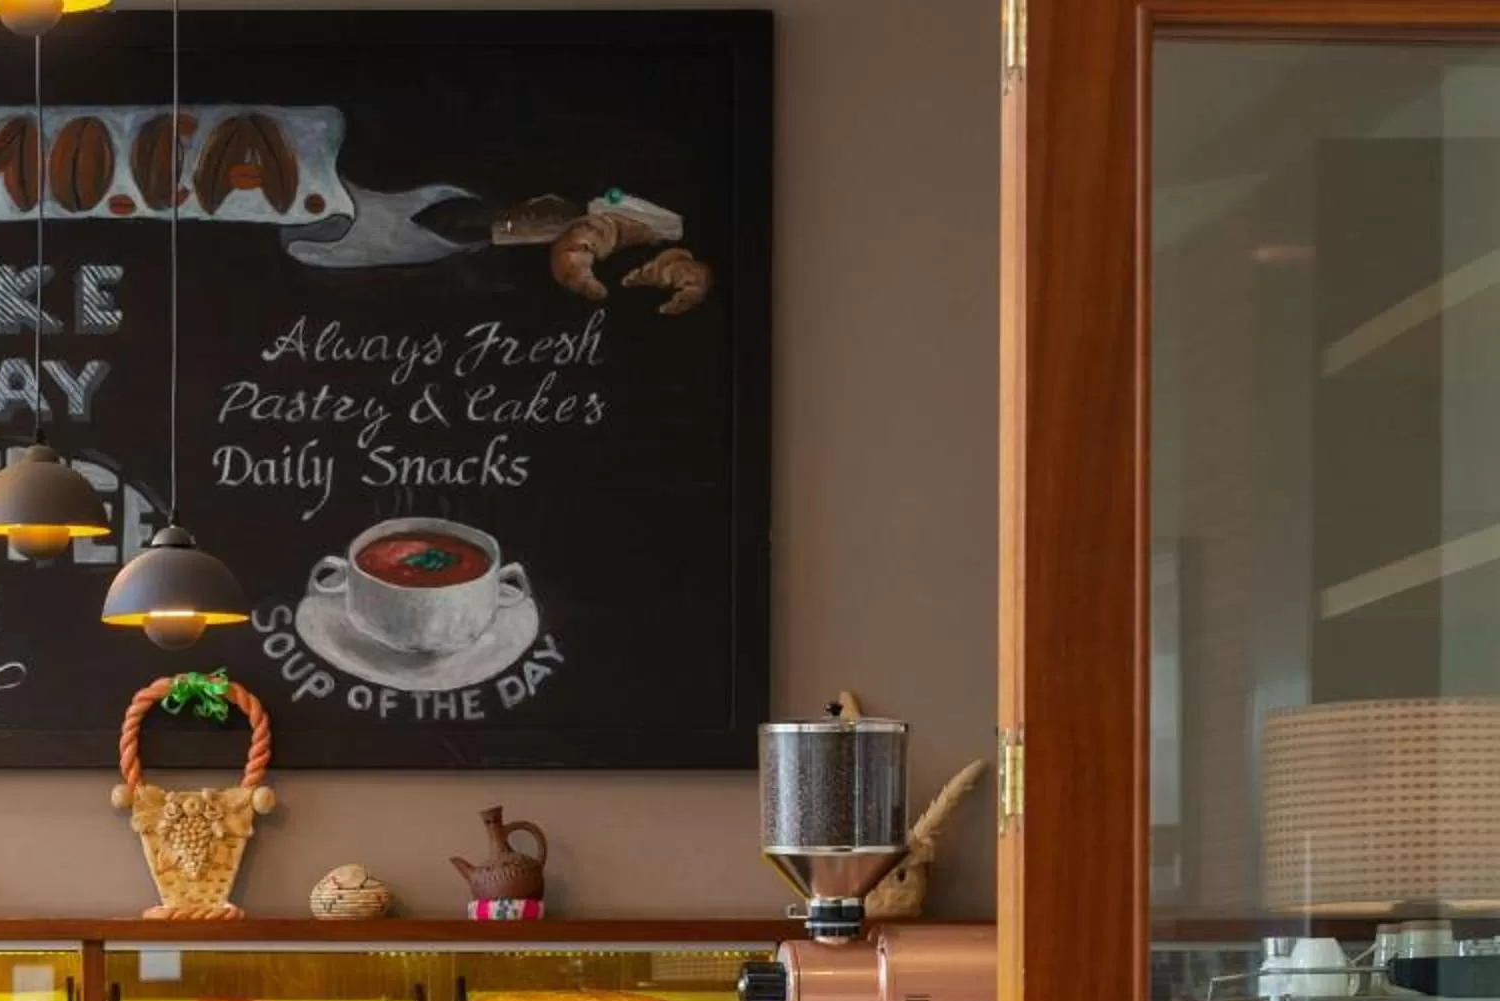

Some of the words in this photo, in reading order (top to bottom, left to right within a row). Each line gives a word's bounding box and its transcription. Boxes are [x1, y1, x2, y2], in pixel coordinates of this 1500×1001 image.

[261, 314, 445, 385] Always
[454, 308, 605, 377] Fresh
[217, 380, 393, 448] Pastry
[409, 384, 450, 428] &
[465, 371, 608, 424] Cakes
[212, 438, 335, 521] Daily
[360, 434, 530, 487] Snacks
[252, 605, 336, 702] SOUP
[347, 685, 399, 719] OF
[411, 689, 486, 721] THE
[496, 634, 564, 710] DAY
